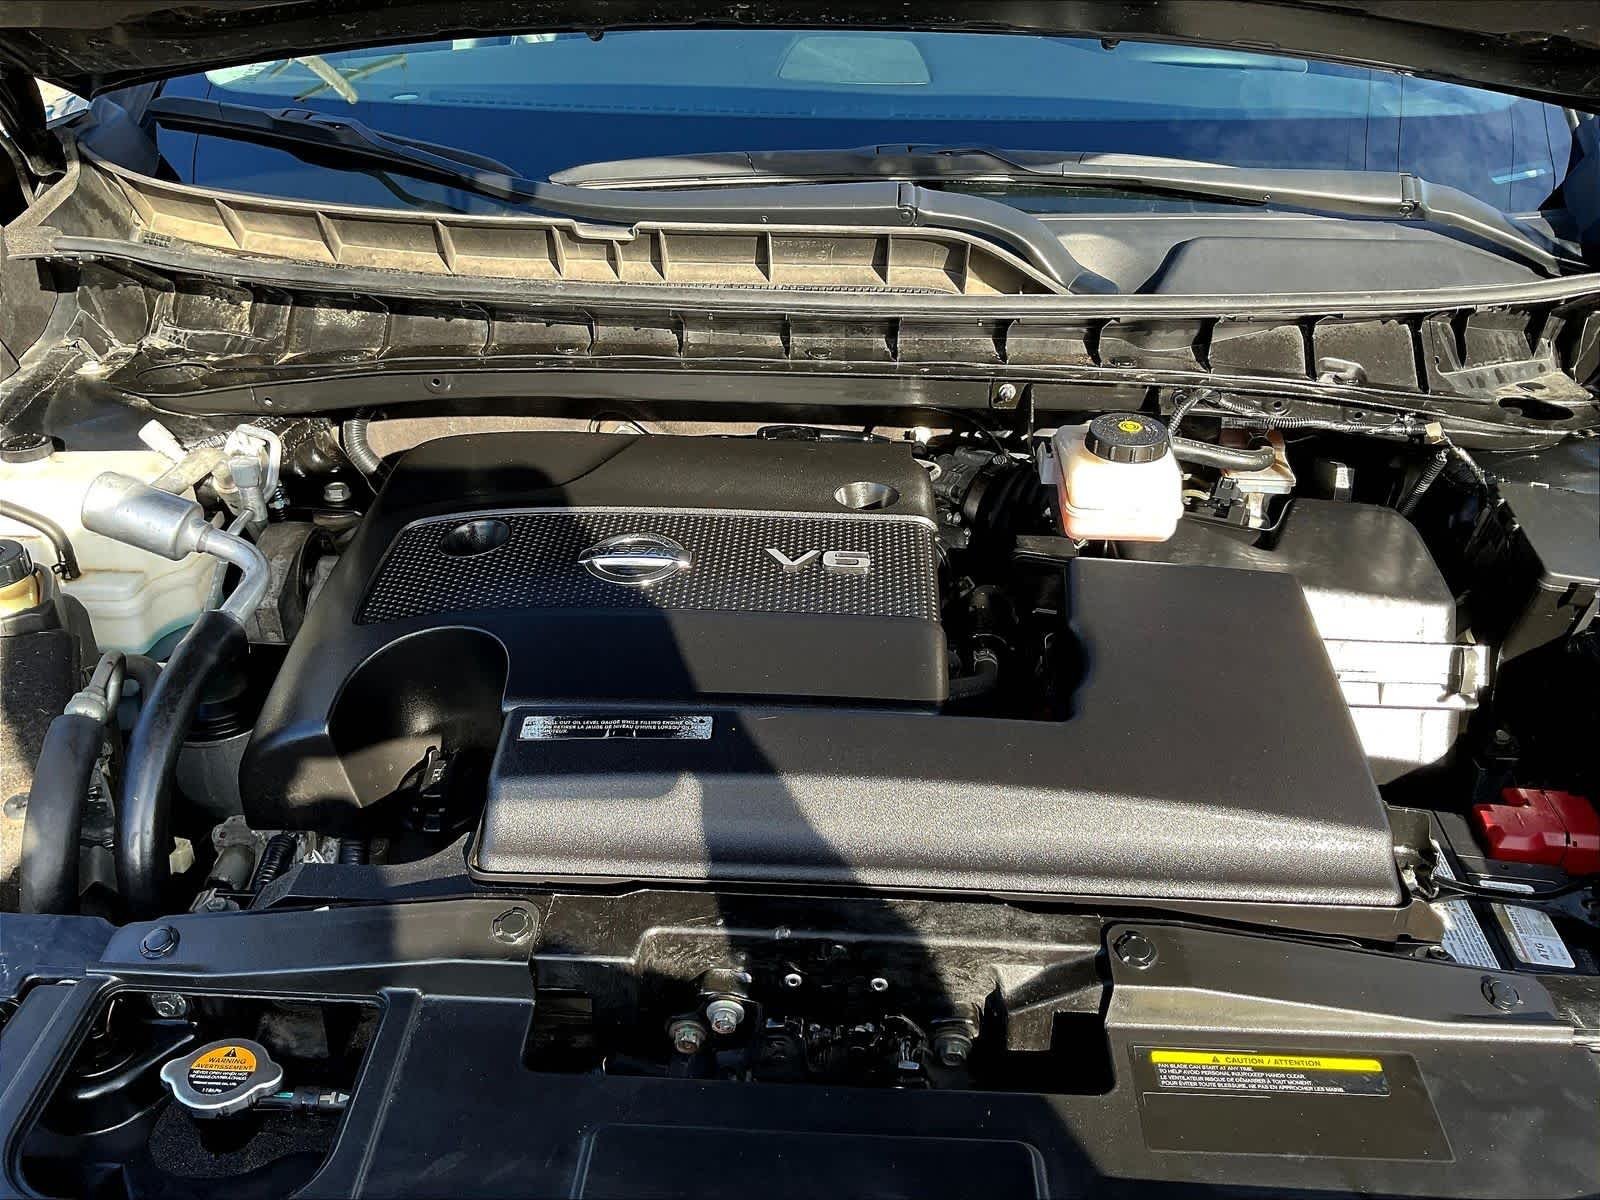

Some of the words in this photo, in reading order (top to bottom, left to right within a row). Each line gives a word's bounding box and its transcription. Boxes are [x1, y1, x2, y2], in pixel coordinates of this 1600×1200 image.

[766, 549, 870, 573] V6
[1225, 1057, 1265, 1065] CAUTION
[1274, 1059, 1321, 1067] ATTENTION
